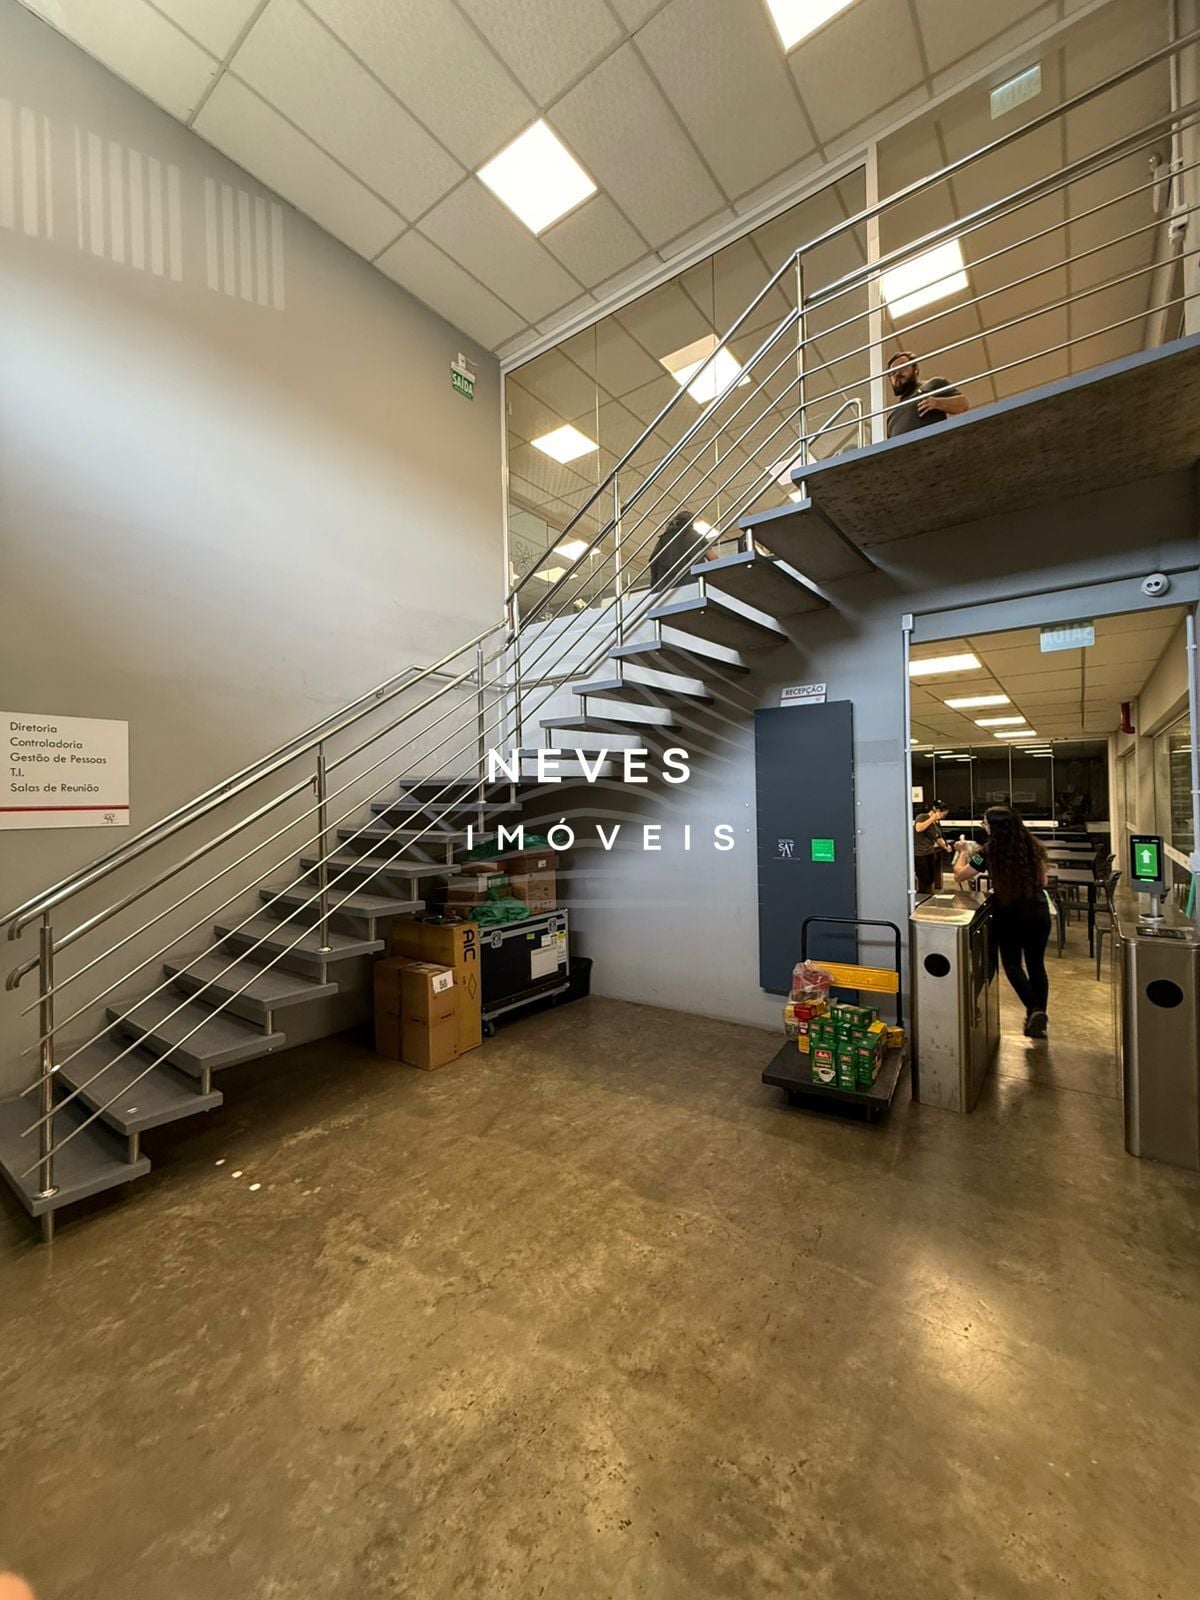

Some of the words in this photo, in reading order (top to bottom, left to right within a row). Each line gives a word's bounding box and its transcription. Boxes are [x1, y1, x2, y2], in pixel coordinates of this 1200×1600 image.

[785, 684, 824, 695] RECEPÇÃO
[9, 721, 58, 733] Diretoria
[9, 737, 83, 749] Controladoria
[9, 752, 50, 763] Gestão
[53, 754, 67, 763] de
[70, 755, 107, 764] Pessoas
[10, 767, 25, 777] T.I.
[10, 782, 40, 792] Salas
[43, 783, 57, 792] de
[60, 783, 100, 792] Reunião
[778, 843, 795, 857] SAT
[463, 929, 476, 962] AIC
